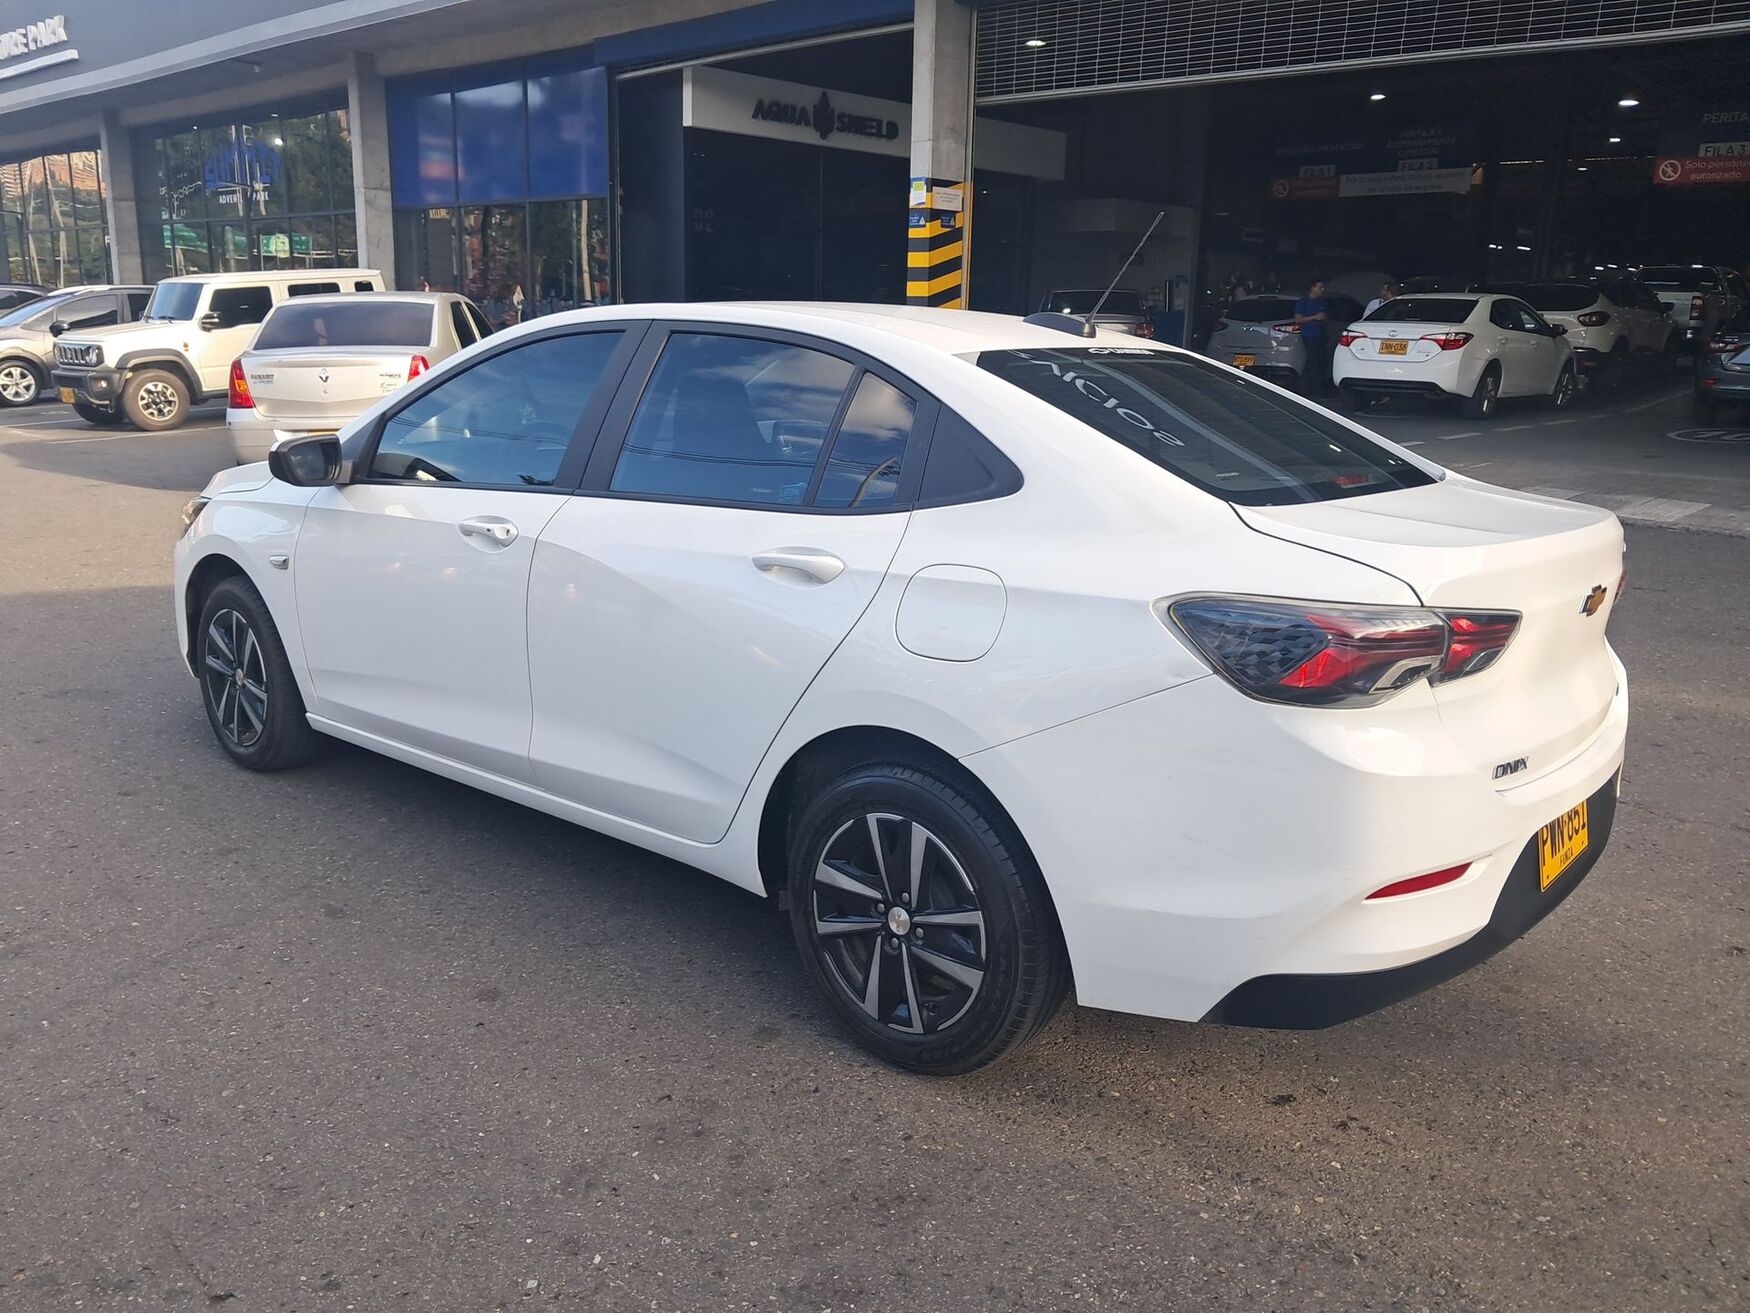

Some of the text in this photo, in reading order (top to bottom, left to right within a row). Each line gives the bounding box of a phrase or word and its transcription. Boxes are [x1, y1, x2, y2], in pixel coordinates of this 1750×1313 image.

[27, 14, 68, 51] PARK
[752, 99, 900, 140] AQUA SHIELD
[1703, 111, 1750, 124] PERITA
[1704, 144, 1747, 157] FILA 3
[1684, 160, 1706, 169] Solo
